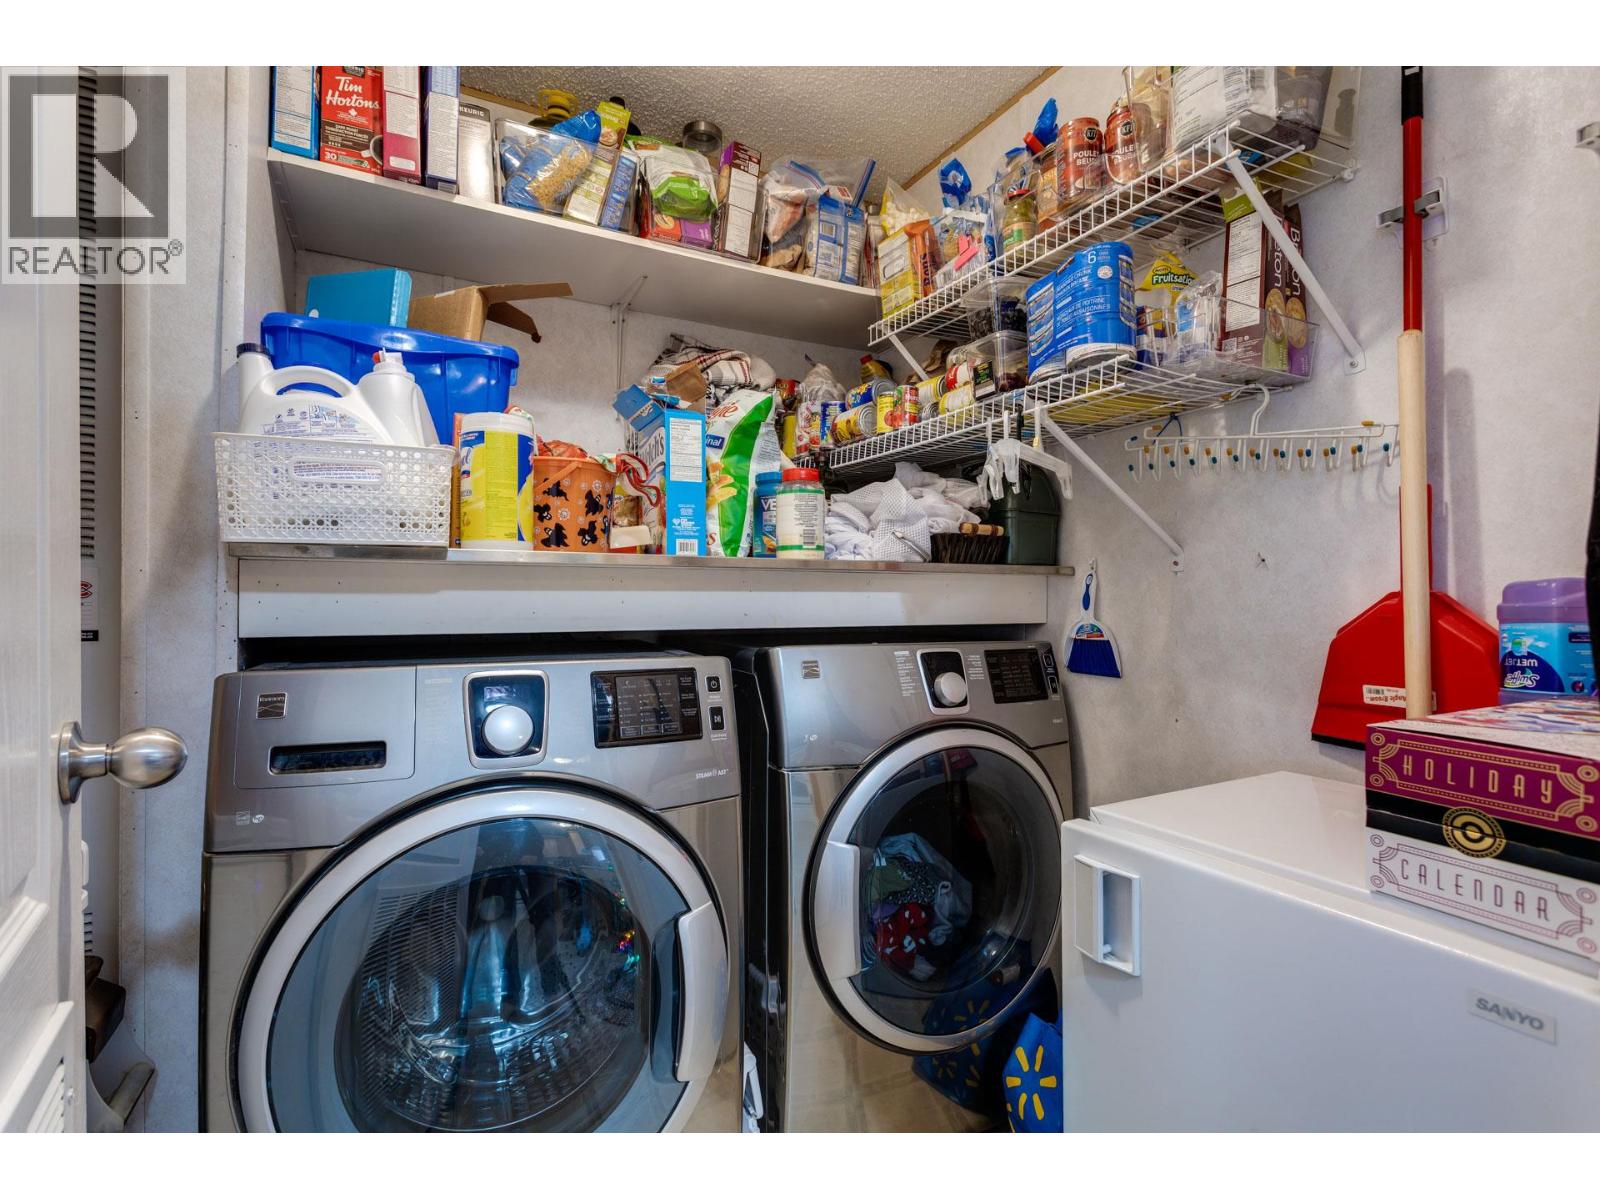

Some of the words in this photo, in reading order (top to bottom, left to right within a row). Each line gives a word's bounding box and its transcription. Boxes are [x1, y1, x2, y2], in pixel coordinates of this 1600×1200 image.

[335, 76, 363, 93] Tim
[325, 89, 381, 110] Hortons
[1087, 250, 1097, 264] 6
[1152, 273, 1194, 285] Fruitsatio
[705, 435, 722, 447] inal
[760, 498, 777, 511] VE
[1402, 755, 1552, 804] HOLIDAY
[1400, 858, 1551, 922] CALENDAR
[1475, 997, 1544, 1031] SANYO
